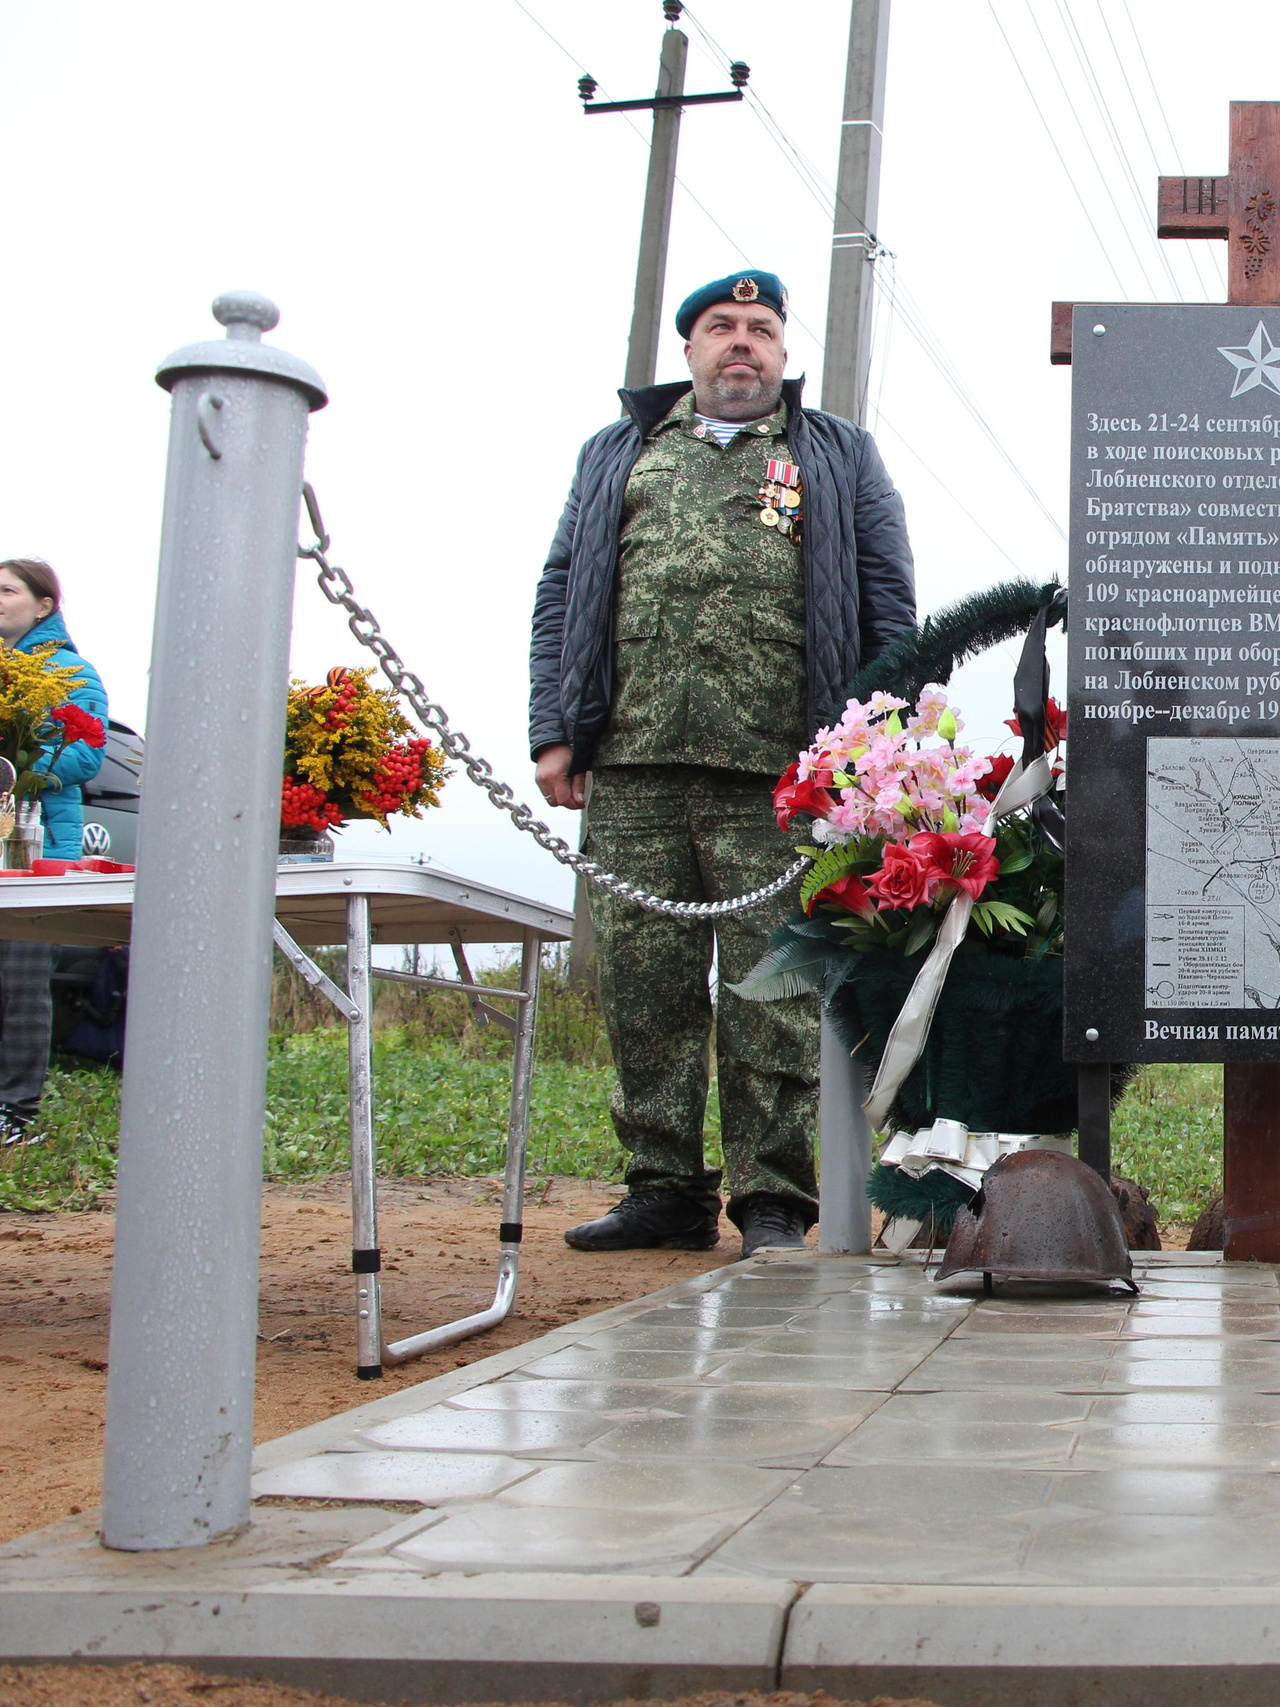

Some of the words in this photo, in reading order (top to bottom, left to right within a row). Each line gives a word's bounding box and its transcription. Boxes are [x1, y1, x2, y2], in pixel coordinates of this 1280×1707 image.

[1086, 412, 1142, 434] Здесь
[1147, 412, 1200, 432] 21-24
[1087, 445, 1099, 460] в
[1104, 445, 1148, 462] ходе
[1152, 446, 1265, 461] поисковых
[1085, 468, 1217, 489] Лобненского
[1085, 497, 1192, 522] Братства»
[1085, 530, 1171, 550] отрядом
[1176, 526, 1279, 546] «Память»
[1085, 553, 1213, 579] обнаружены
[1219, 560, 1232, 574] и
[1085, 582, 1119, 603] 109
[1084, 612, 1243, 637] краснофлотцев
[1084, 640, 1188, 661] погибших
[1193, 646, 1233, 667] при
[1084, 675, 1109, 690] на
[1113, 670, 1240, 691] Лобненском
[1084, 699, 1251, 725] ноябре--декабре
[1143, 1019, 1220, 1040] Вечная
